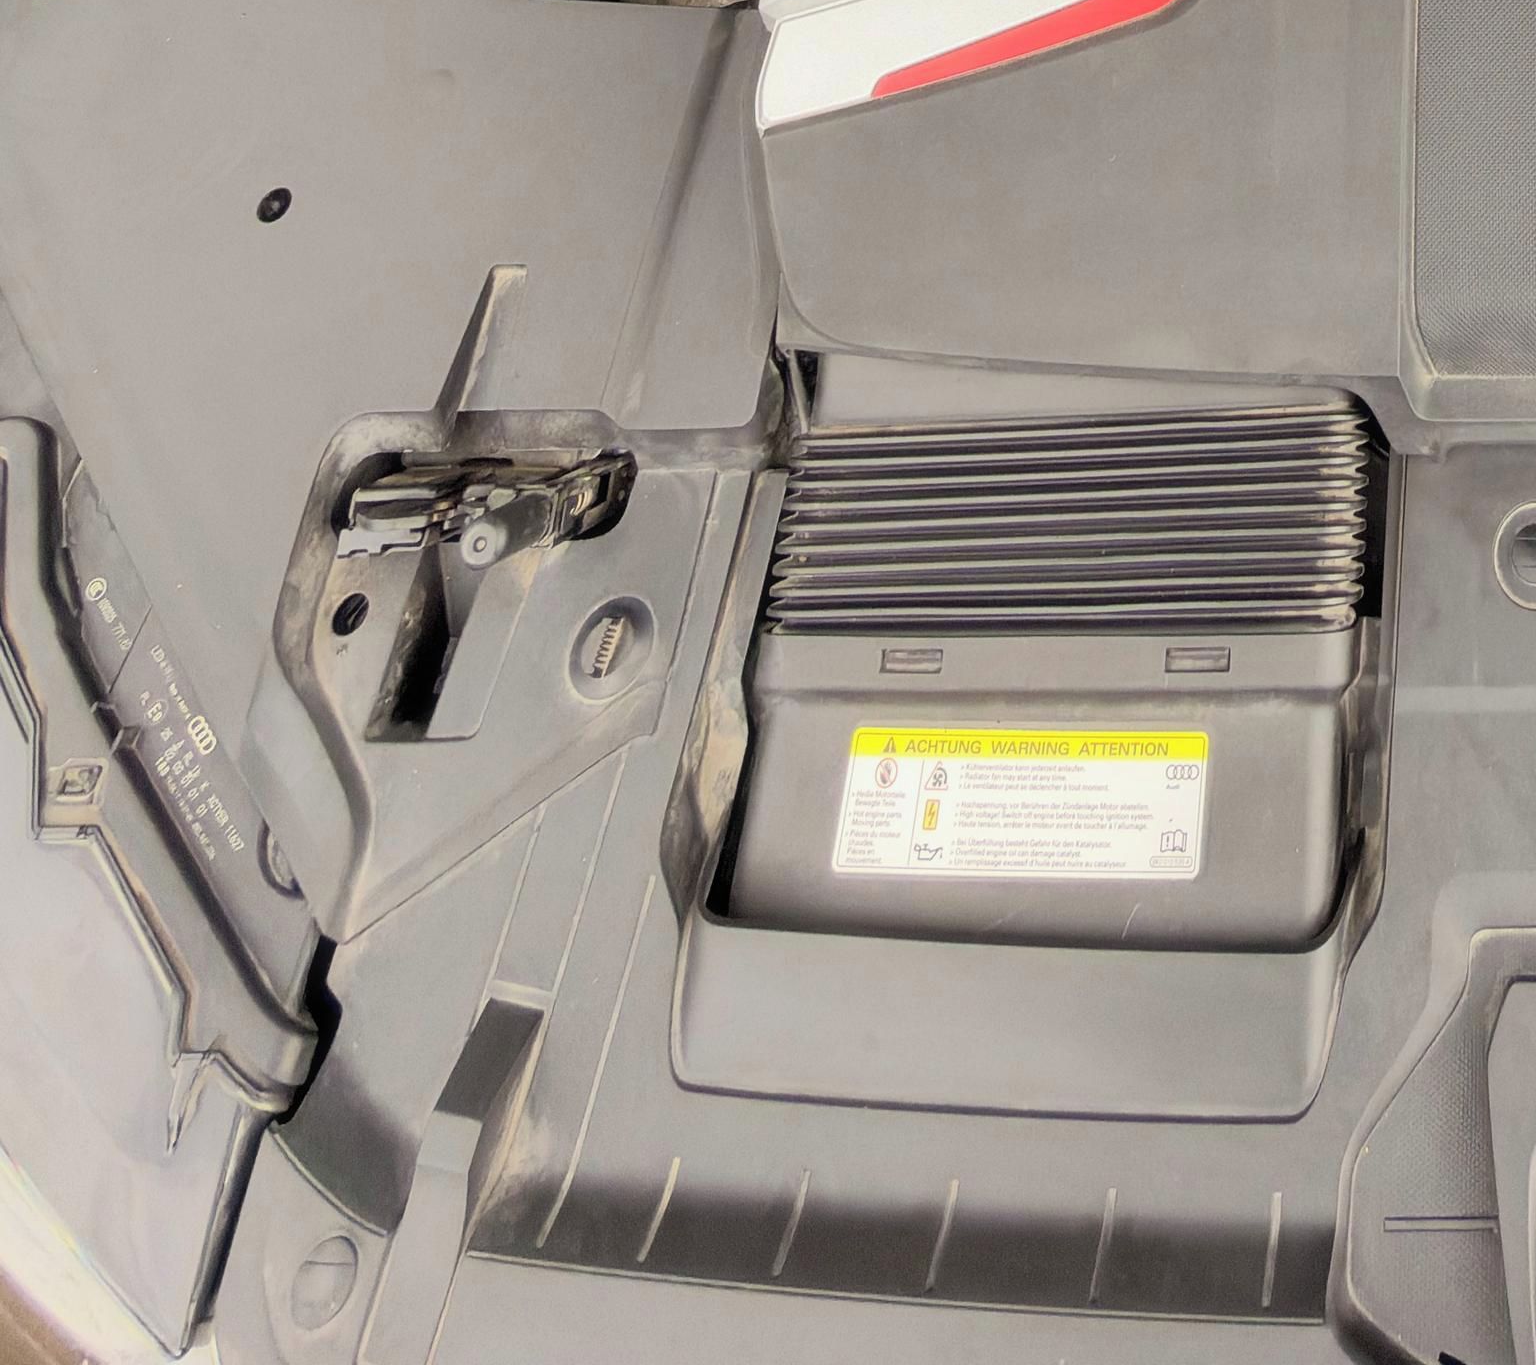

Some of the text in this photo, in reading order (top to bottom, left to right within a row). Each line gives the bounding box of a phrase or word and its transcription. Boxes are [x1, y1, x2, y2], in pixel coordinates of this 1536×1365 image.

[904, 739, 1169, 757] ACHTUNG WARNING ATTENTION
[1017, 773, 1031, 781] start
[960, 811, 973, 819] High
[1077, 812, 1105, 820] touching
